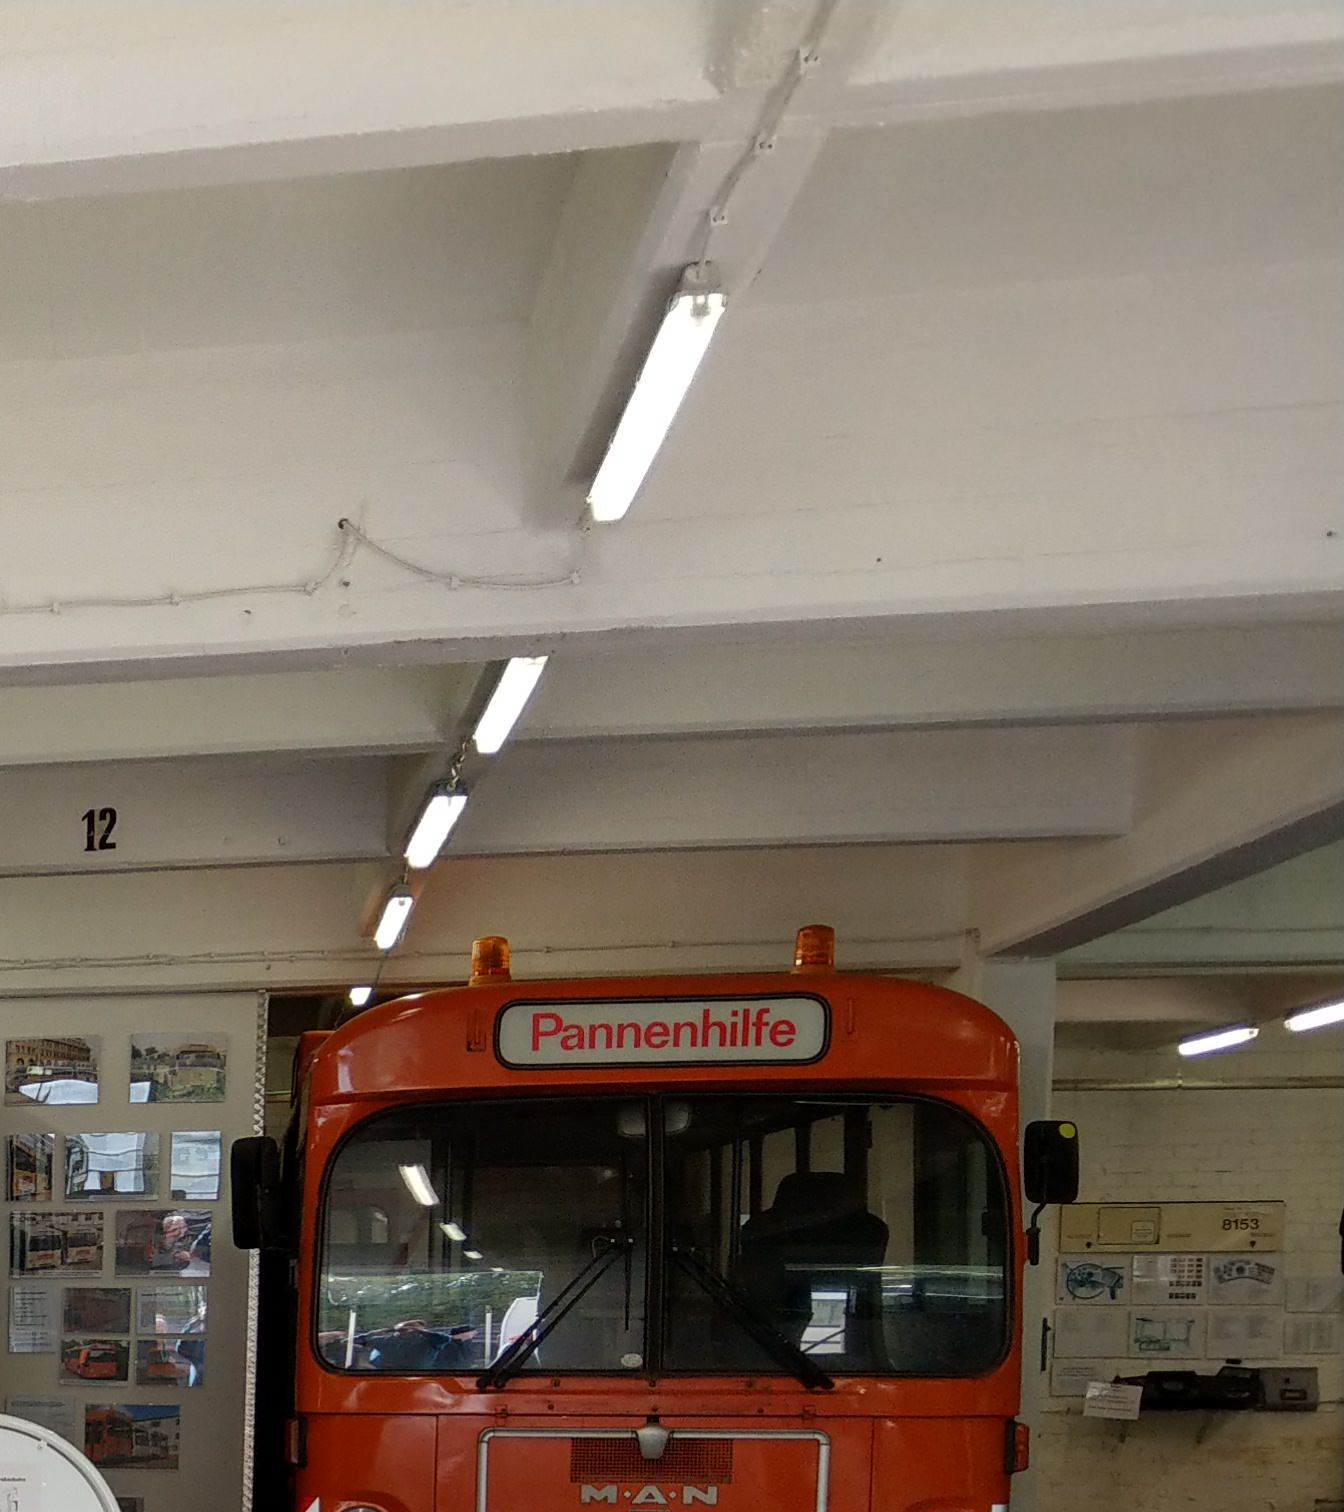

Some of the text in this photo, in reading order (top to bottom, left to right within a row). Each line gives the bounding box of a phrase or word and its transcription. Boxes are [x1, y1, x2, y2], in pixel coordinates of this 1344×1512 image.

[81, 807, 117, 852] 12
[530, 1007, 797, 1052] Pannenhilfe
[1221, 1217, 1260, 1232] 8153
